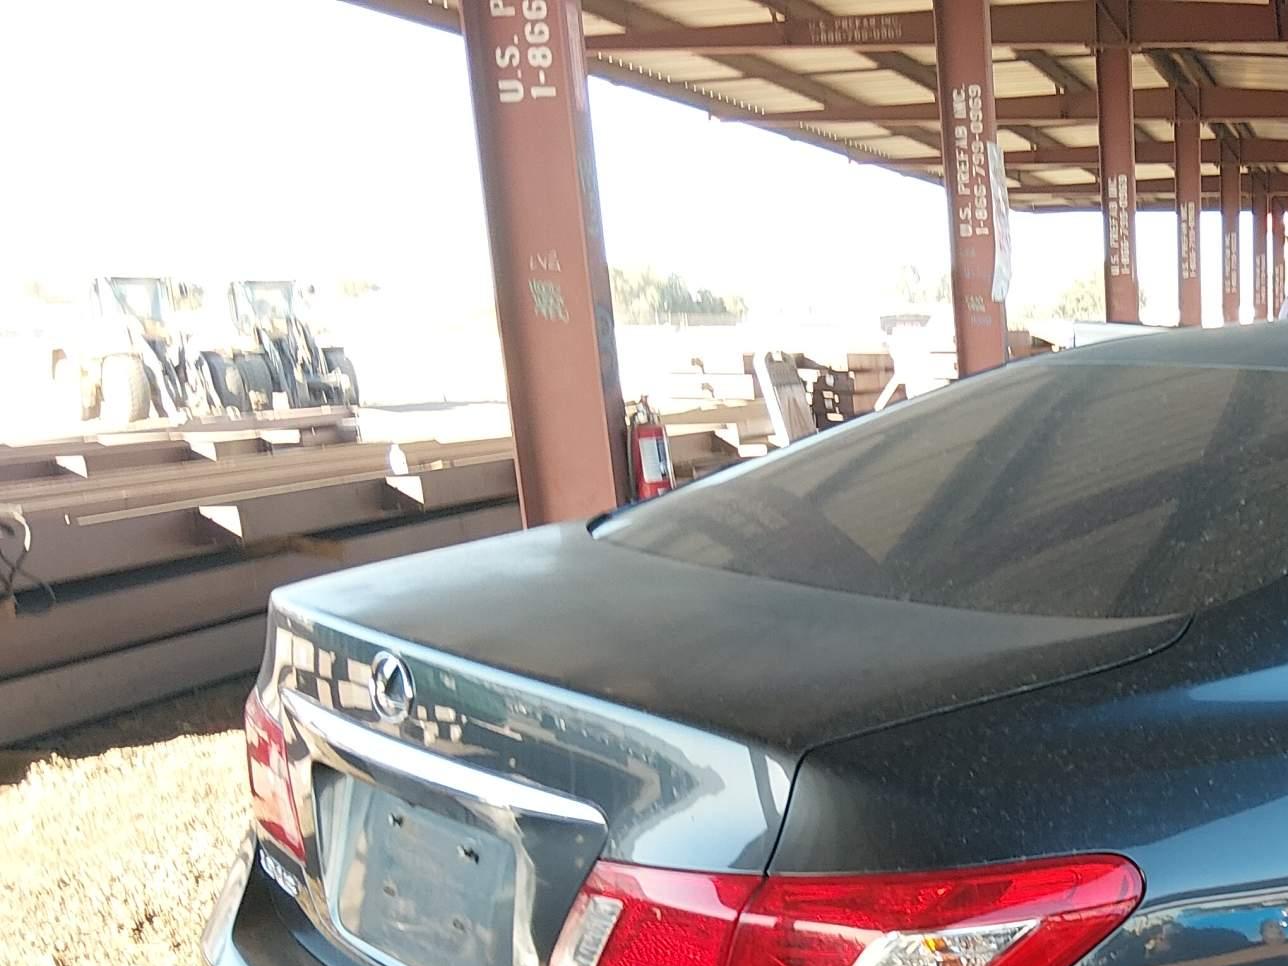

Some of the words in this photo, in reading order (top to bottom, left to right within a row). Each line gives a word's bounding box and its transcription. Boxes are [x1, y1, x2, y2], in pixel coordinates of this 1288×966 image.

[494, 34, 525, 103] U.S.
[952, 82, 967, 119] INC.
[955, 126, 970, 195] PREFAB
[968, 84, 989, 235] 1-866-799-0969
[959, 201, 973, 237] U.S.
